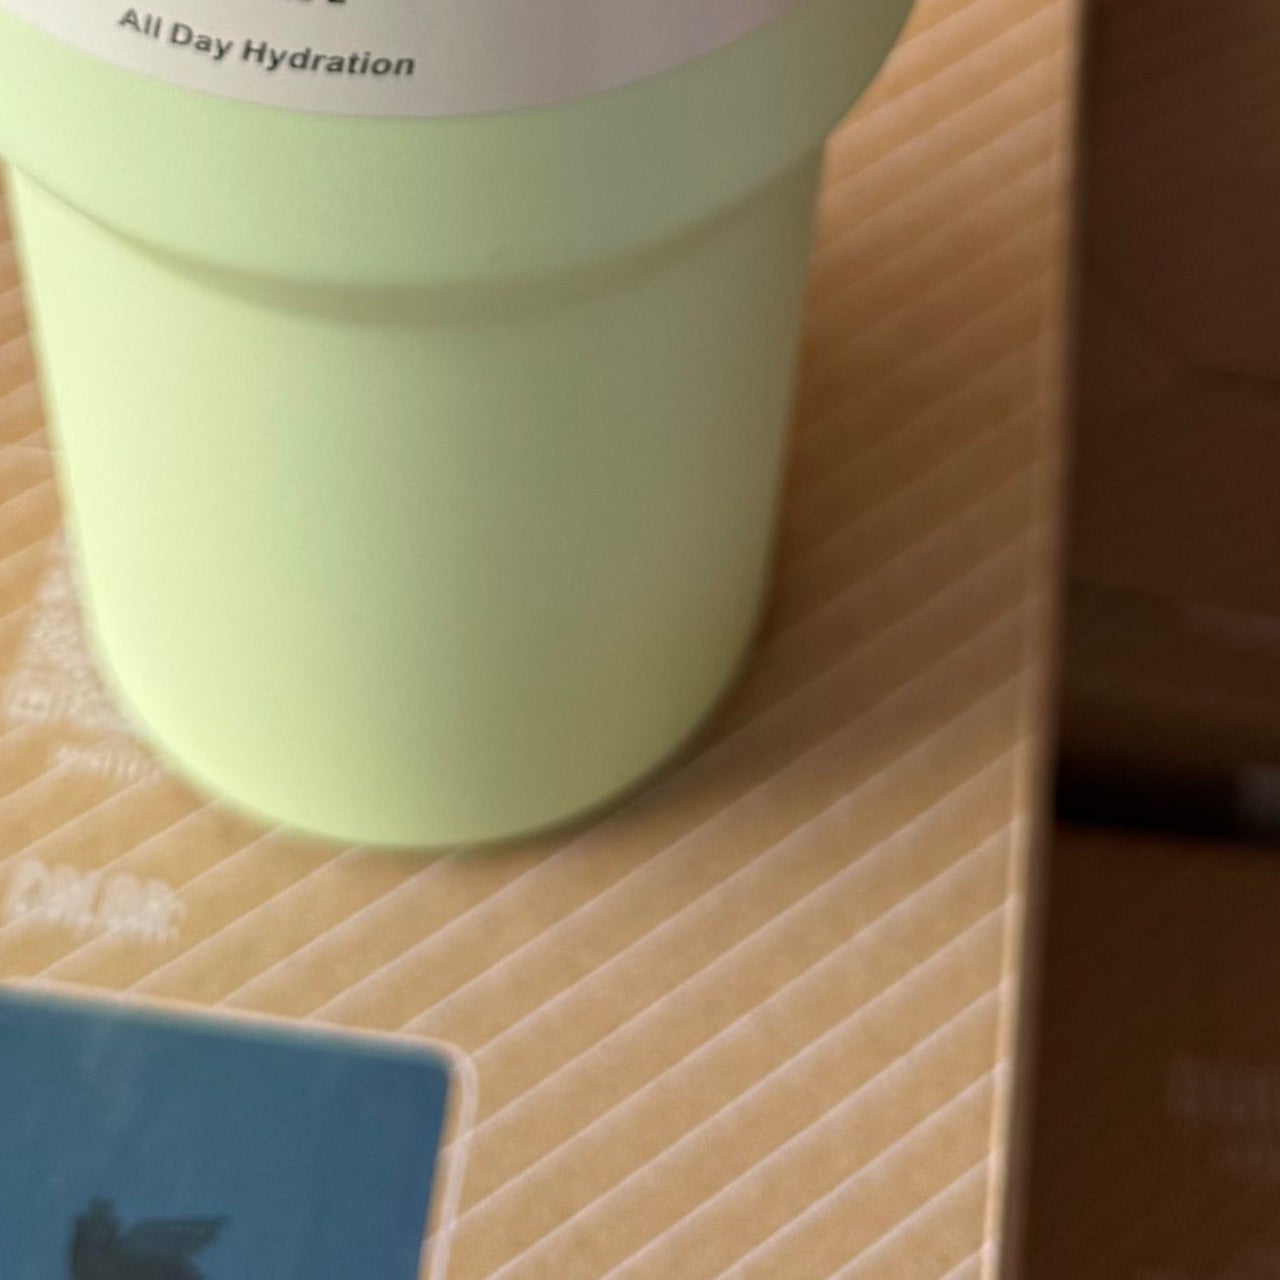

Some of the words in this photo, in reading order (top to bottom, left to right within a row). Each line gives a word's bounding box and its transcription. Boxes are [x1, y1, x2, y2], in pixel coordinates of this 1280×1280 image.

[118, 7, 163, 39] All
[170, 21, 234, 62] Day
[241, 38, 417, 77] Hydration
